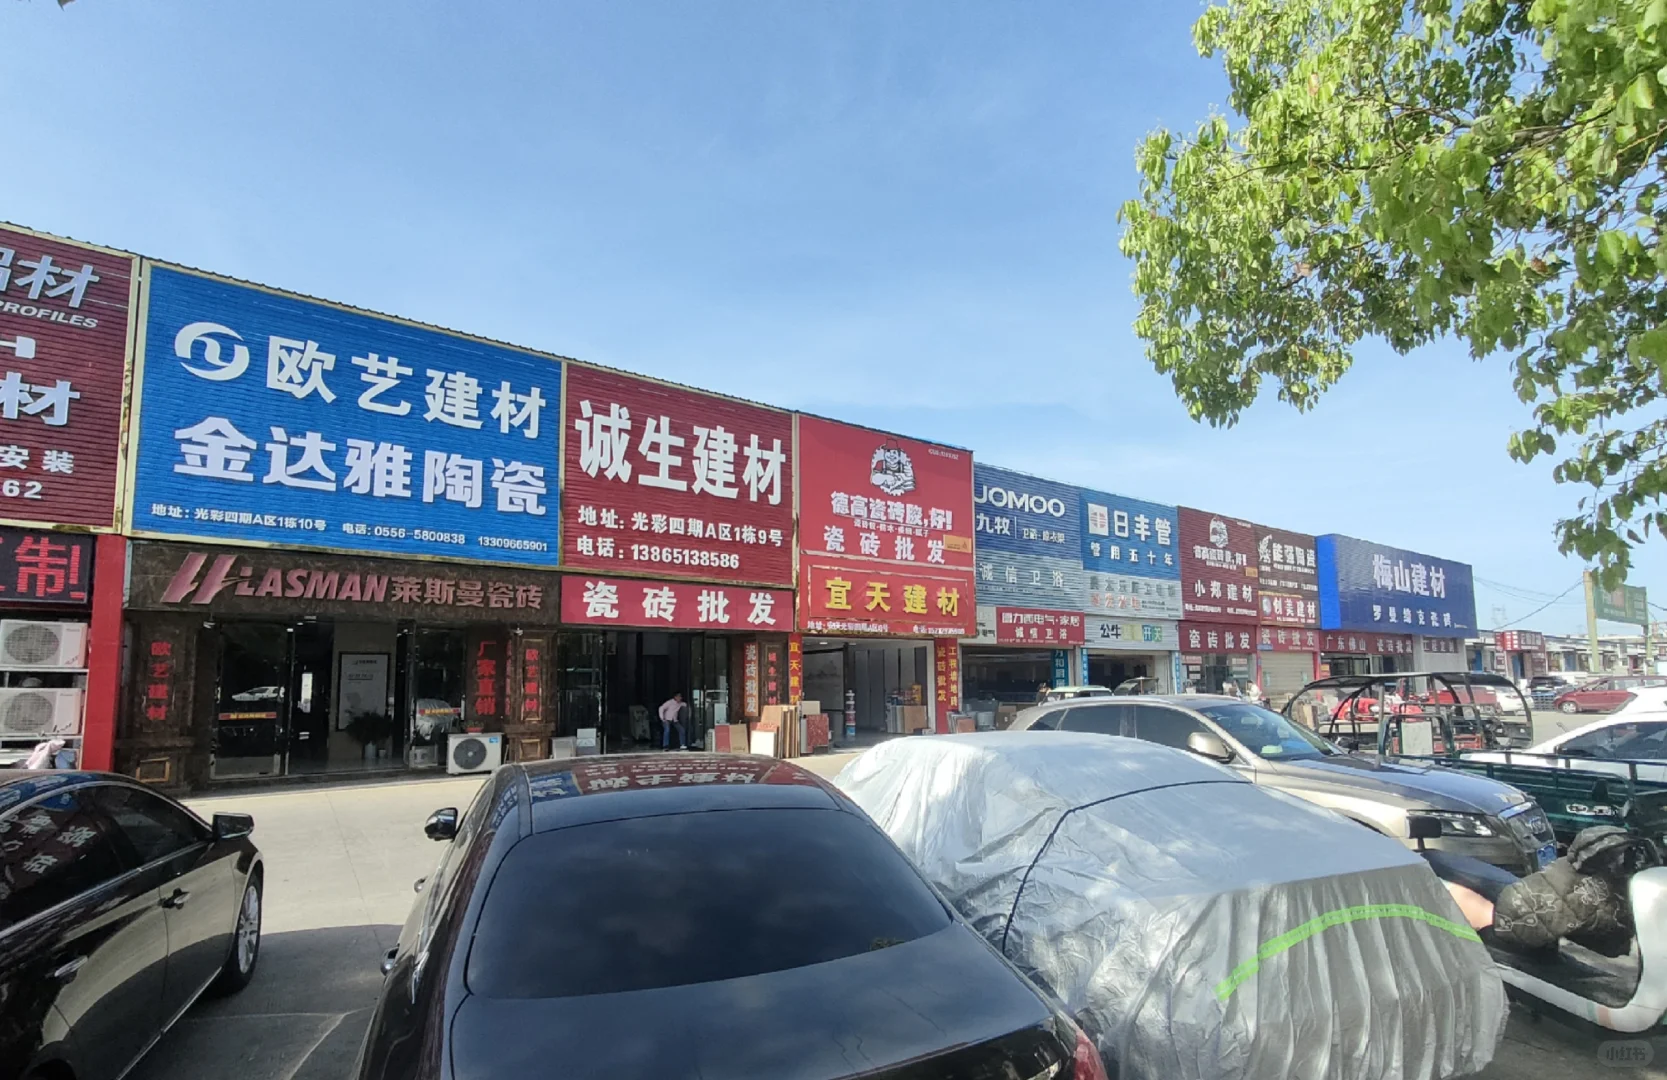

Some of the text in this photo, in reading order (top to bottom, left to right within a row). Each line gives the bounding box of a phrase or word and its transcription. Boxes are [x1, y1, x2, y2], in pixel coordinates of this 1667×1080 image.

[266, 334, 547, 439] 欧艺建材
[173, 416, 547, 516] 金达雅陶瓷
[575, 400, 786, 505] 诚生建材
[974, 485, 1065, 517] JOMOO
[976, 513, 1010, 536] 九牧
[1113, 510, 1171, 546] 日丰管
[823, 525, 945, 564] 瓷砖批发
[1090, 541, 1173, 567] 管用五十年
[391, 575, 544, 610] 莱斯曼瓷砖
[979, 563, 1064, 588] 诚信卫浴
[1372, 553, 1446, 599] 梅山建材
[583, 581, 776, 625] 瓷砖批发
[825, 576, 960, 616] 宜天建材
[1189, 629, 1250, 649] 瓷砖批发
[475, 641, 497, 716] 厂家直销
